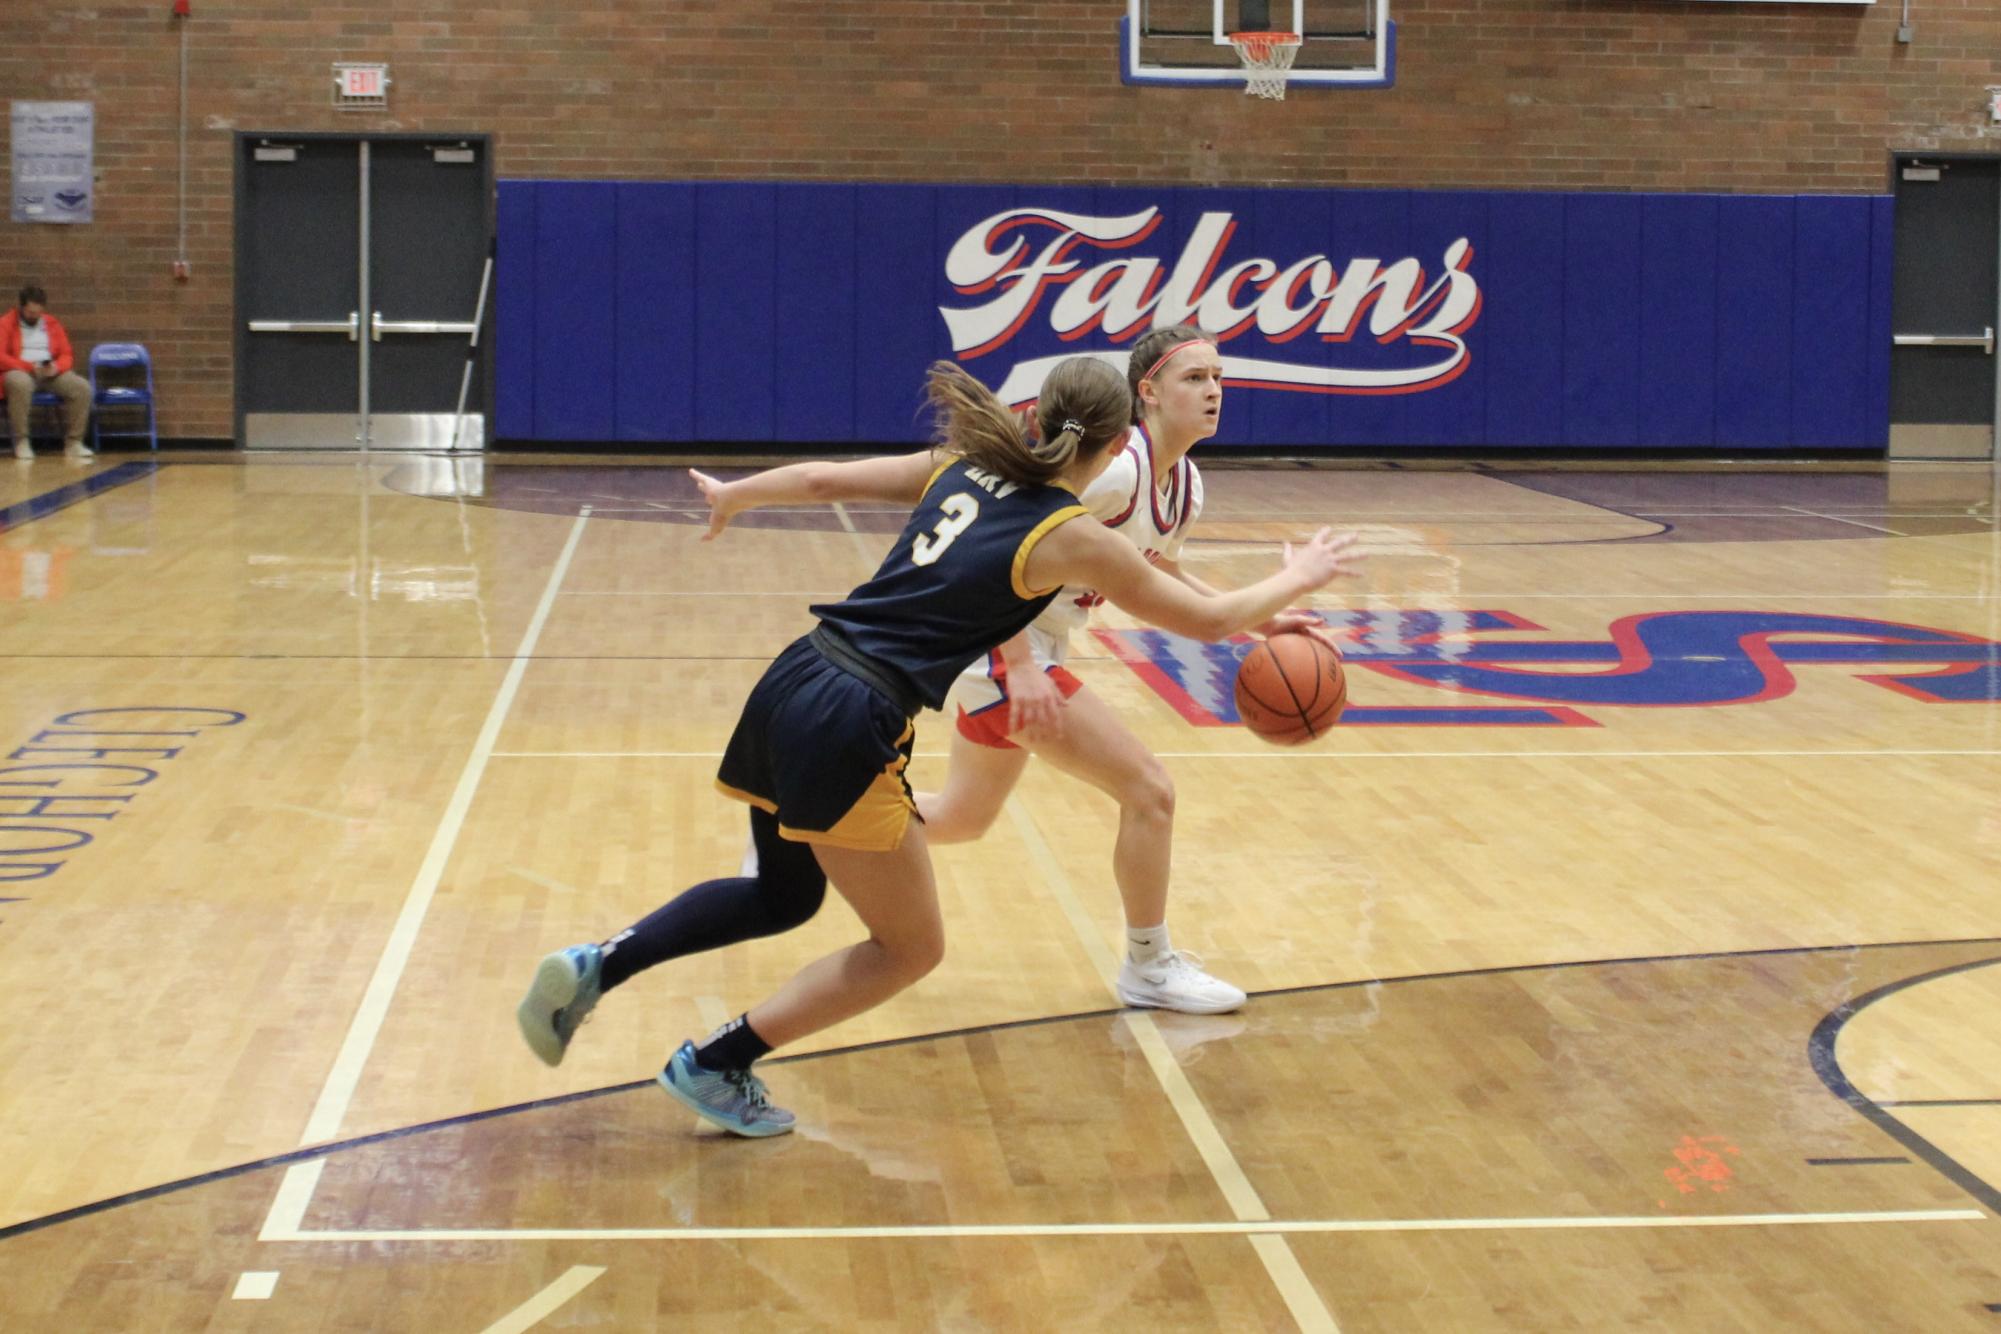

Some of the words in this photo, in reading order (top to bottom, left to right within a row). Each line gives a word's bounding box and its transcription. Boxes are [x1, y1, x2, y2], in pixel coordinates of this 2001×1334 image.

[350, 70, 378, 94] EXIT
[938, 205, 1483, 364] Falcons
[911, 491, 980, 567] 3
